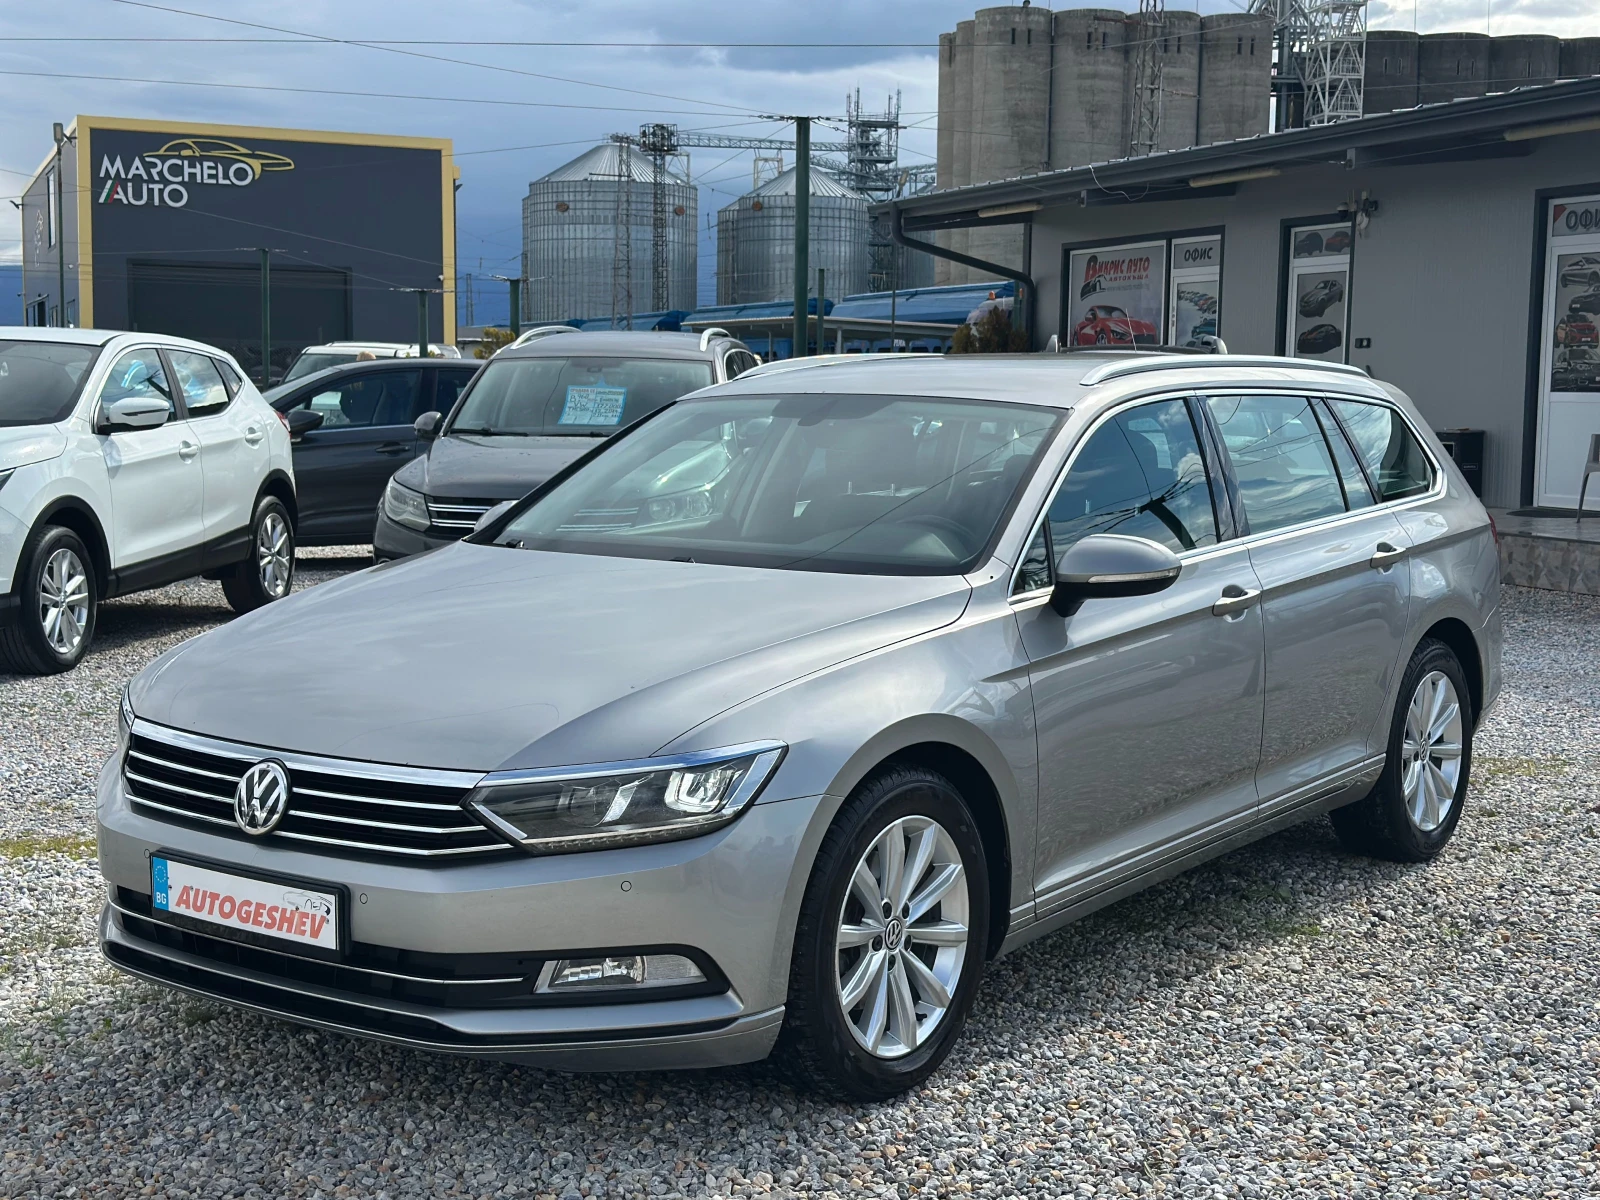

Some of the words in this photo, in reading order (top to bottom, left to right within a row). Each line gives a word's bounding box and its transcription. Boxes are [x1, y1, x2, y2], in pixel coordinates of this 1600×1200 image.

[100, 153, 254, 187] MARCHELO
[98, 179, 189, 208] AUTO
[1184, 247, 1213, 262] ОФИС
[156, 891, 167, 904] BG
[175, 885, 327, 940] AUTOGESHEV
